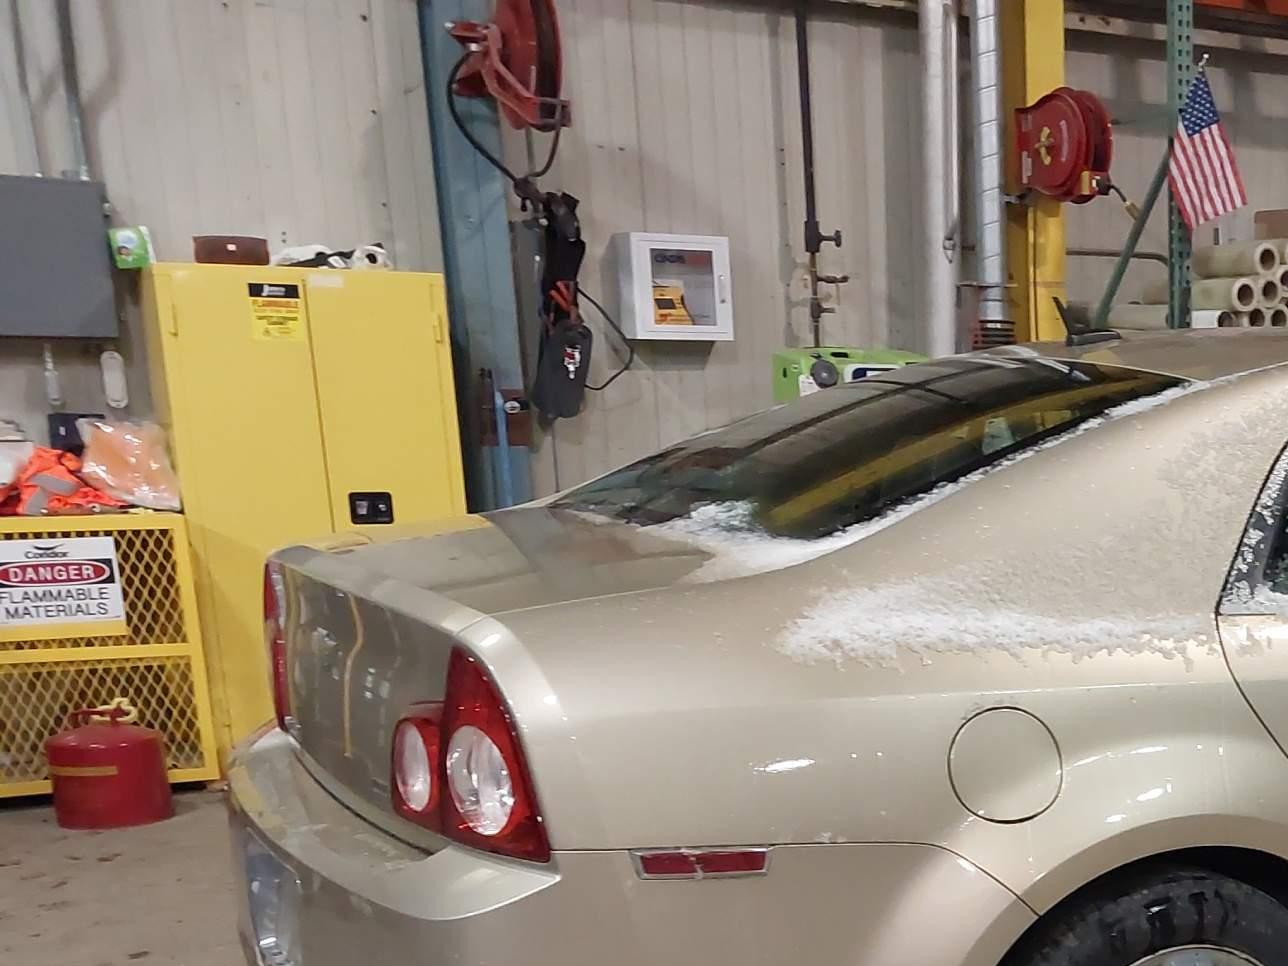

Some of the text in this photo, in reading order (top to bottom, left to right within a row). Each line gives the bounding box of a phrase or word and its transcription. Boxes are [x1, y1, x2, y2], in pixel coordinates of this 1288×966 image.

[24, 551, 69, 560] Condor
[8, 565, 95, 582] DANGER
[0, 587, 110, 605] FLAMMABLE
[5, 602, 109, 620] MATERIALS
